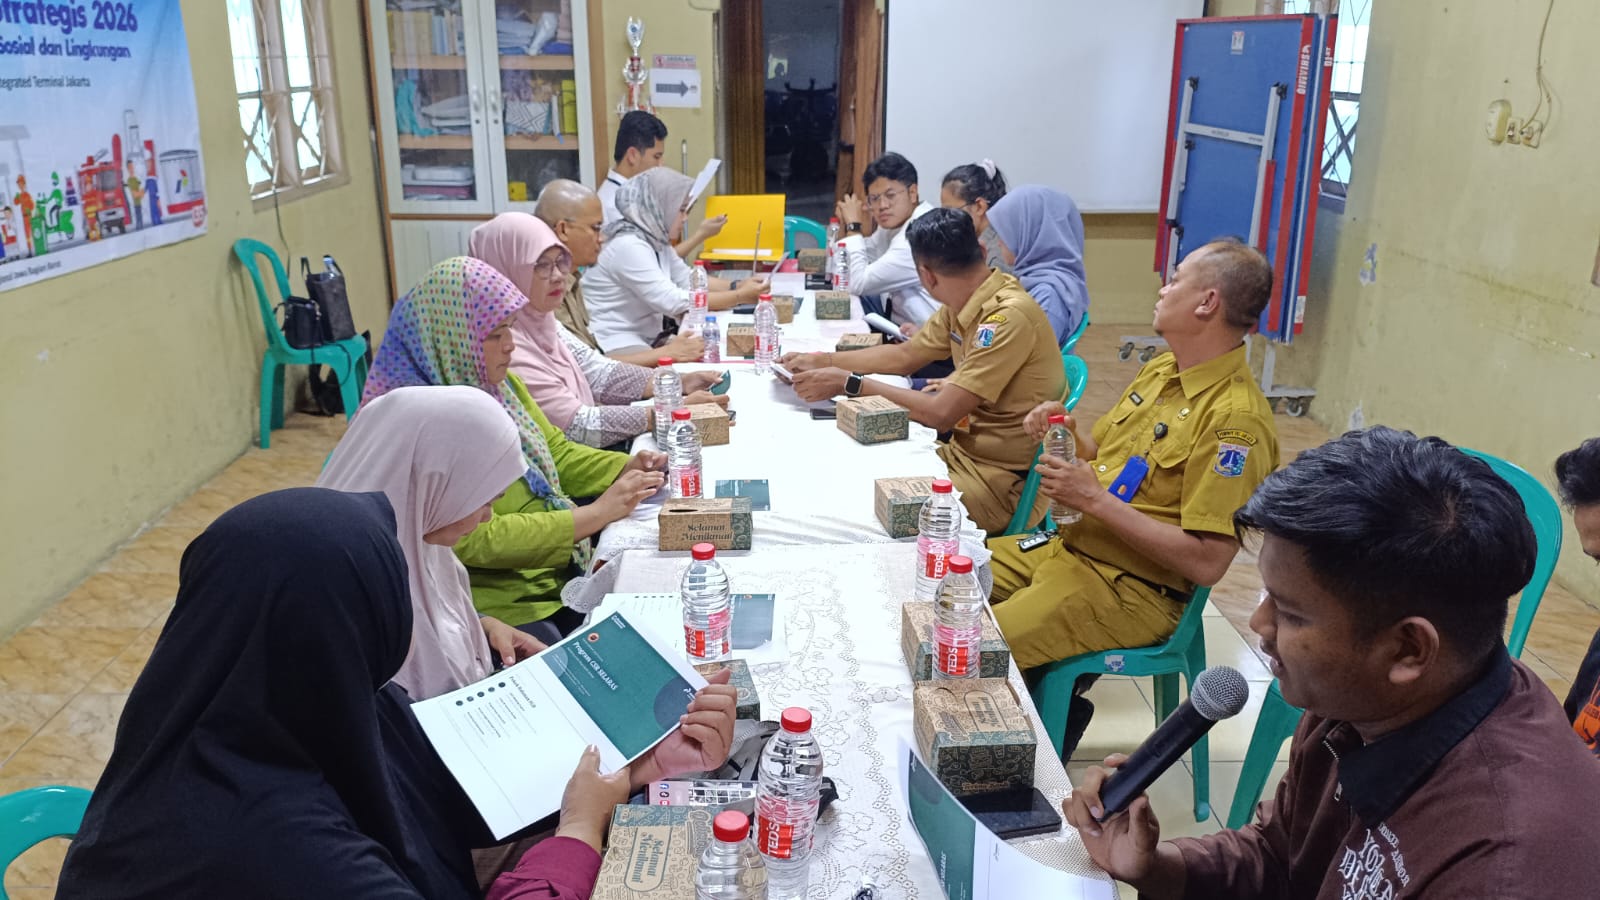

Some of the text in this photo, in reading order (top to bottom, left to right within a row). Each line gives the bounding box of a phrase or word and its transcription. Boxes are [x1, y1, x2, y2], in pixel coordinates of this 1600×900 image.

[0, 0, 138, 34] trategis 2026
[39, 37, 63, 56] dan
[65, 38, 132, 61] Lingkungan
[65, 75, 91, 88] Jakarta
[682, 532, 733, 541] Menikmati
[688, 523, 726, 532] Selamat
[571, 640, 594, 664] Program
[631, 833, 653, 883] Menikmati
[647, 840, 665, 877] Selamat
